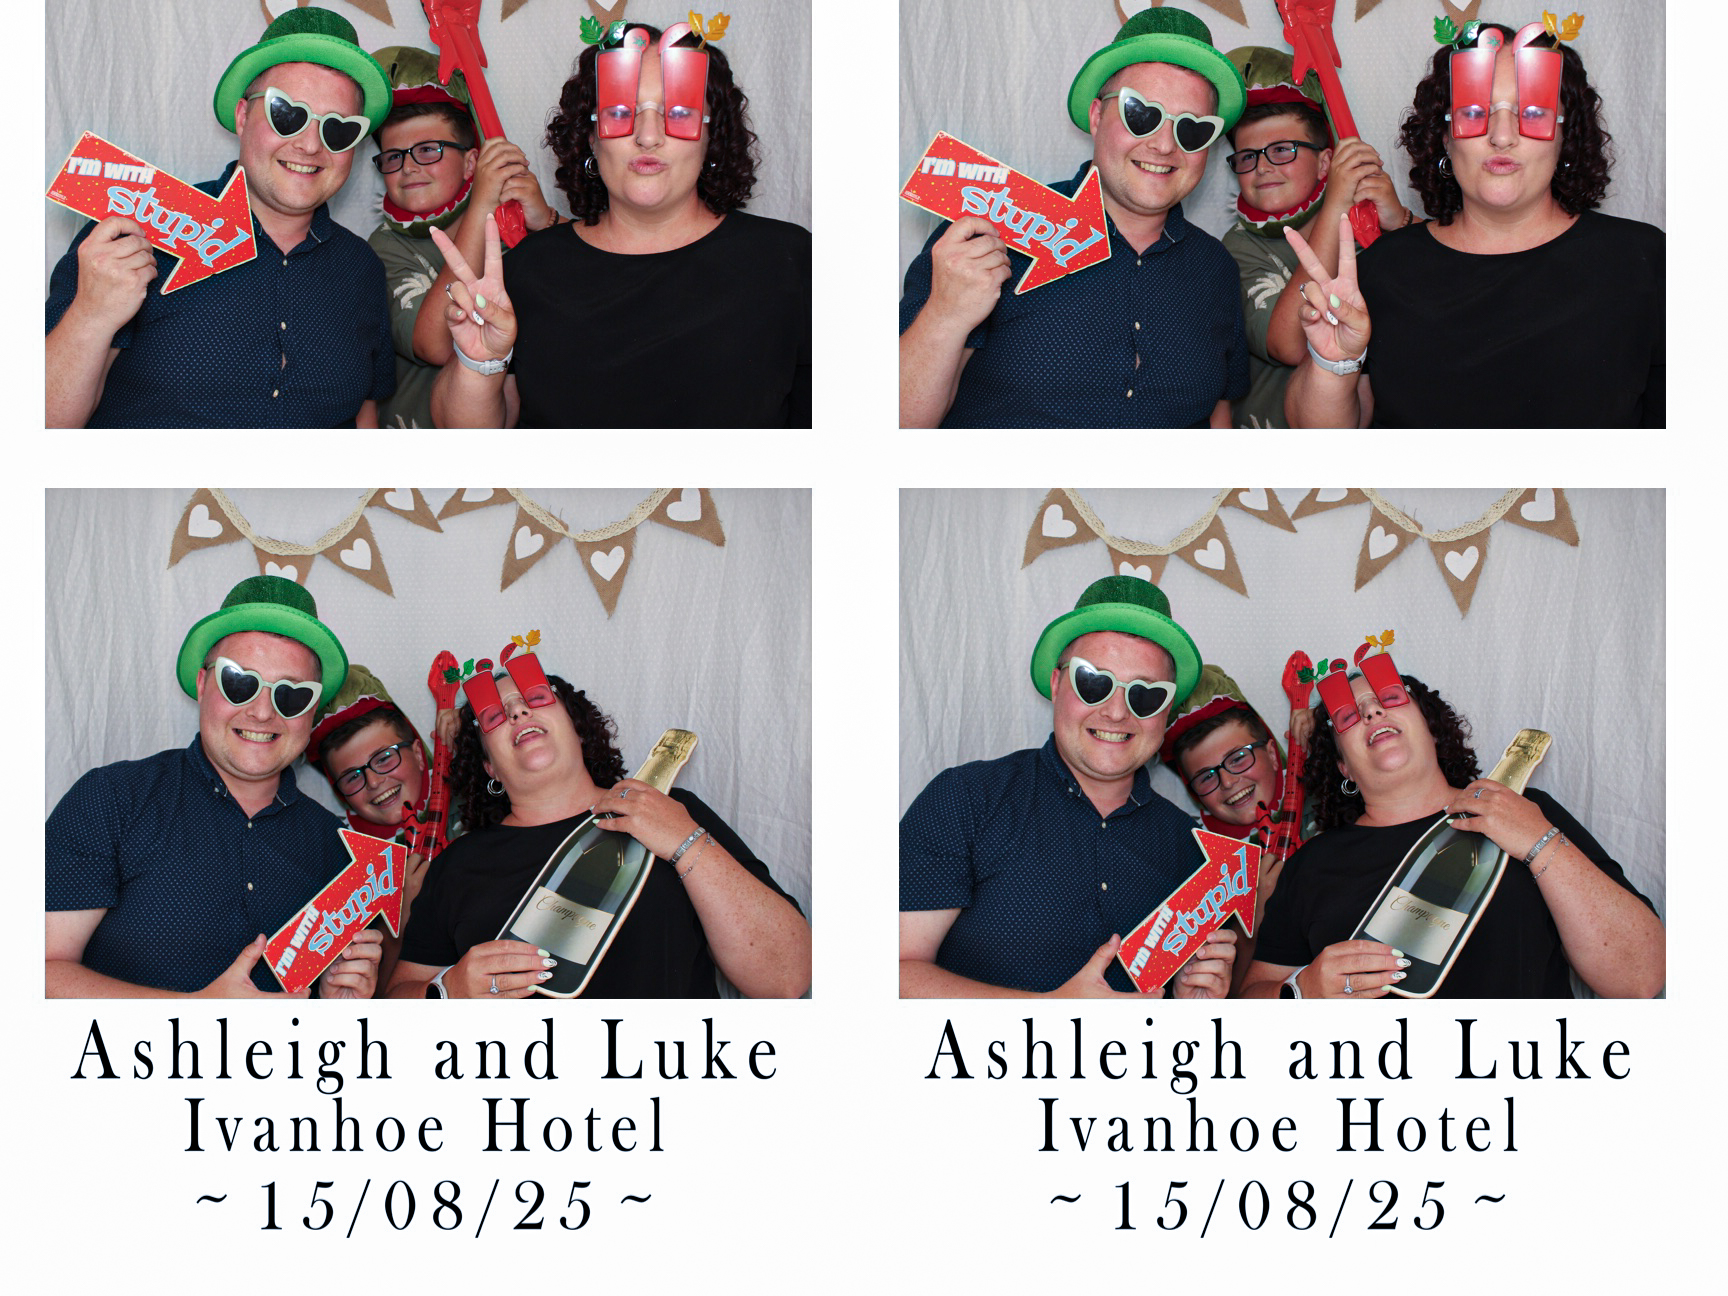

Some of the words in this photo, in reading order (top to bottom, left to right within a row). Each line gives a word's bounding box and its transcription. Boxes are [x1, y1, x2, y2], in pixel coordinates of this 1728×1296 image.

[104, 162, 155, 184] WITH
[958, 162, 1009, 184] WITH
[107, 186, 251, 268] stupid
[961, 186, 1105, 268] stupid
[308, 845, 398, 956] stupid
[536, 895, 597, 931] Champagne
[1162, 845, 1252, 956] stupid
[1390, 895, 1451, 931] Champagne
[290, 905, 320, 949] WITH
[1144, 905, 1174, 949] WITH
